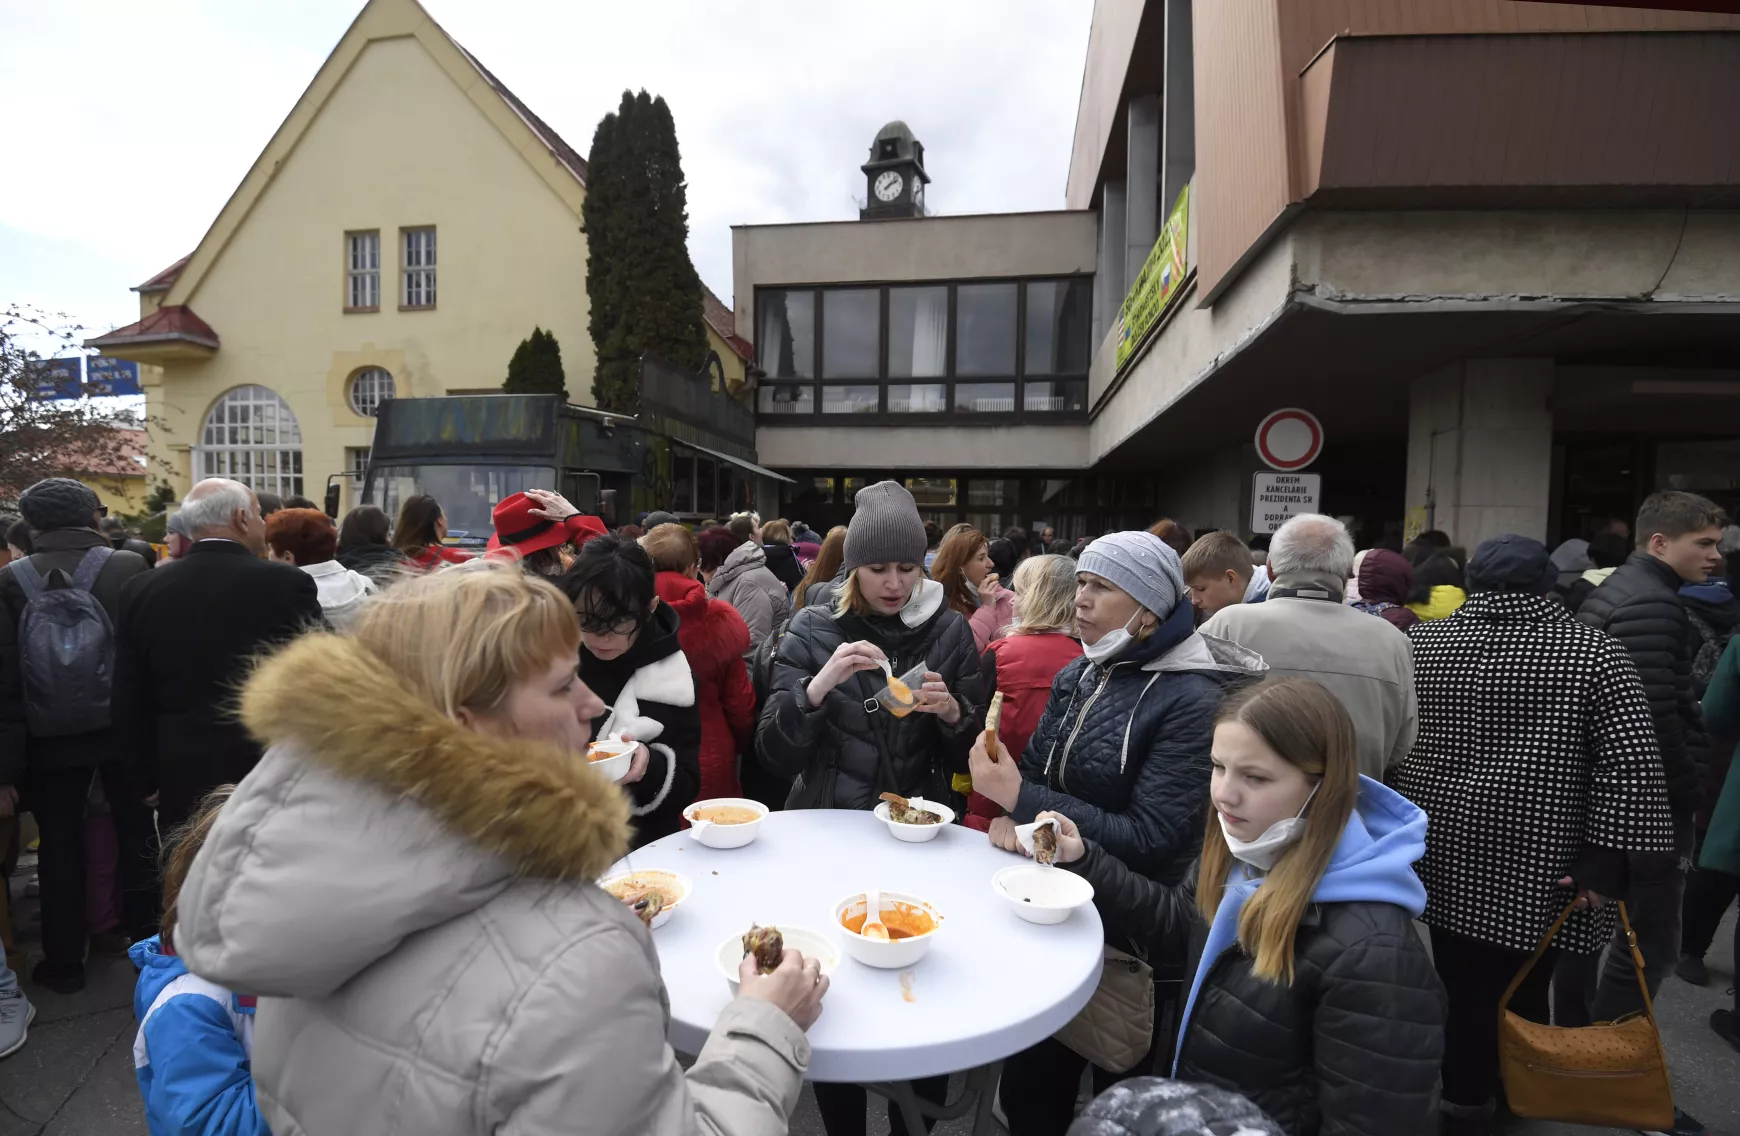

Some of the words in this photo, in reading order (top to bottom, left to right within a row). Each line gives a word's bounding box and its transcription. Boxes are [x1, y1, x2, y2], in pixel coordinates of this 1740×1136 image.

[1276, 476, 1300, 484] OKREM
[1260, 494, 1301, 503] PREZIDENTA
[1264, 513, 1296, 521] DOPRAV
